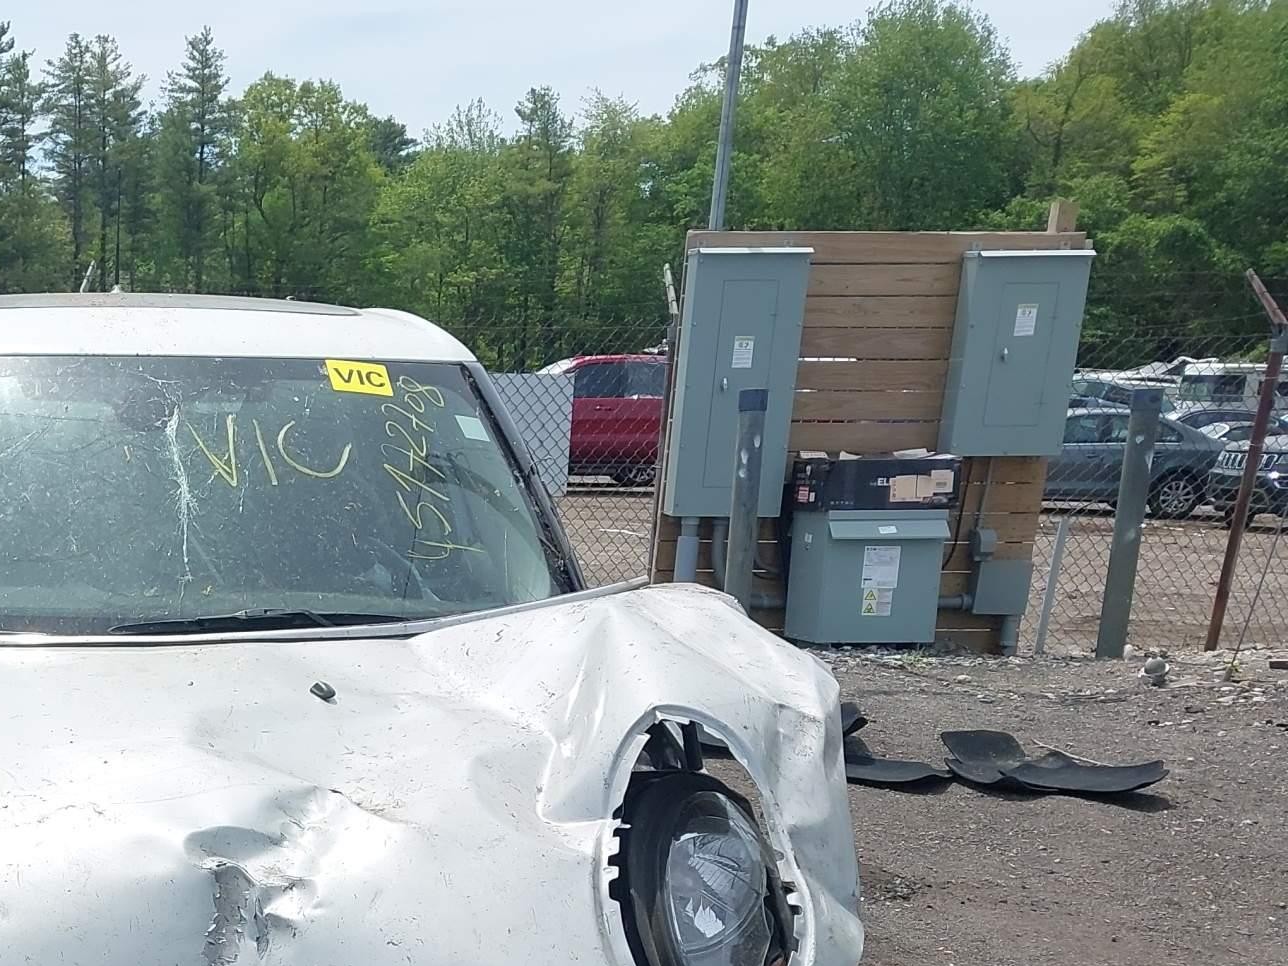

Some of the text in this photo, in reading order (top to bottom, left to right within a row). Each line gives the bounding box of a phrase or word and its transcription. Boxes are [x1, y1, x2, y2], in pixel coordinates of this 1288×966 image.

[332, 366, 387, 389] VIC
[186, 412, 353, 488] VIC
[381, 374, 487, 561] 45172708
